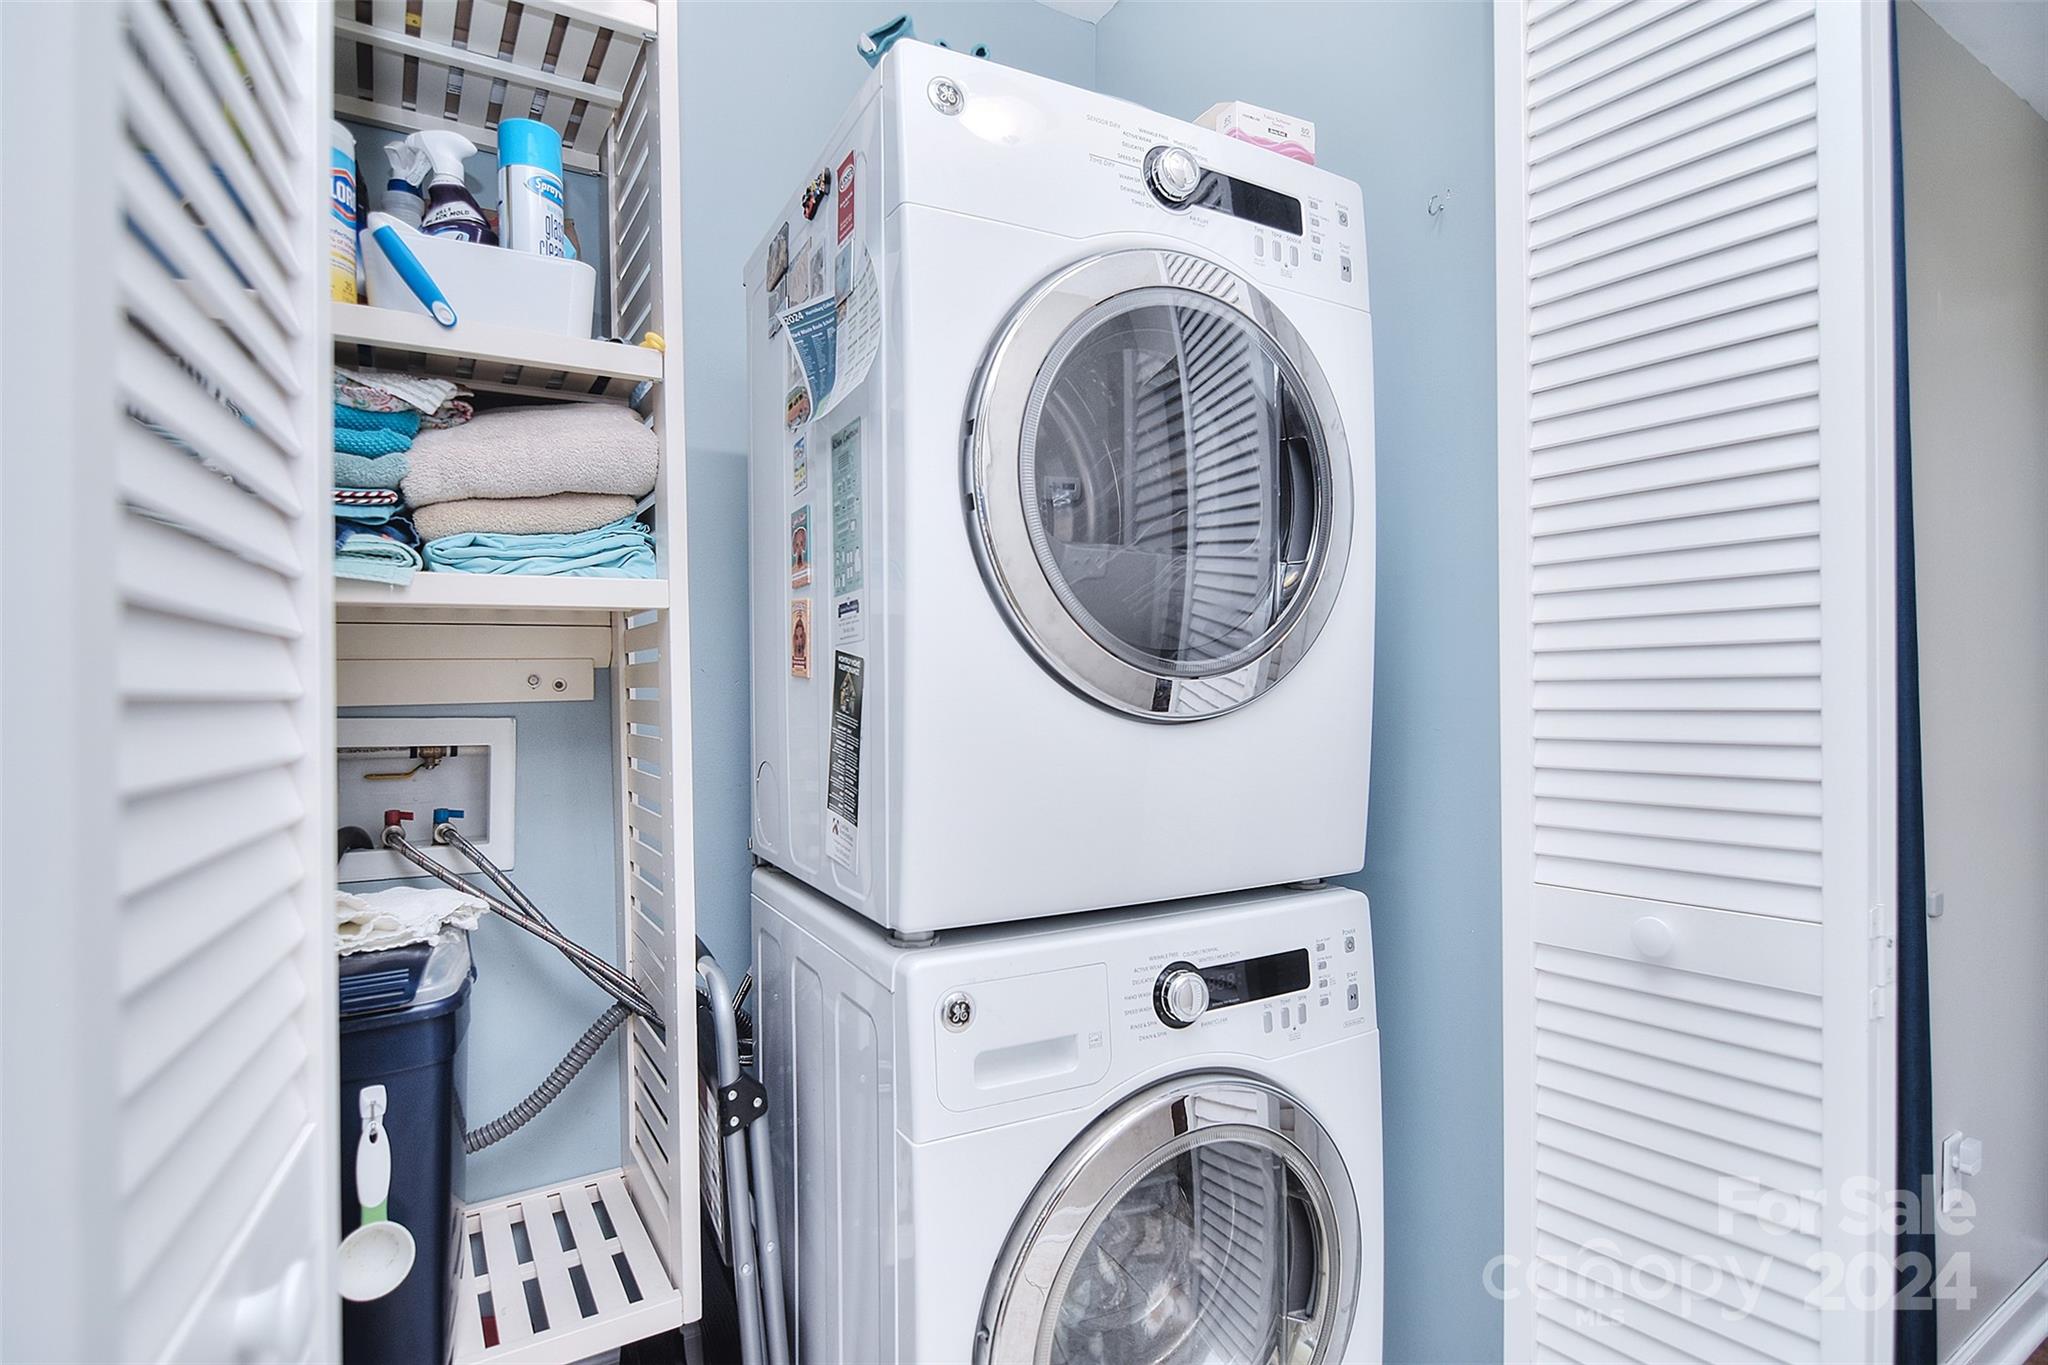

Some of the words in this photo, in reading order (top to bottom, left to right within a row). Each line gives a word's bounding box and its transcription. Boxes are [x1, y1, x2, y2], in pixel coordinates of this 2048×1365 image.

[449, 210, 470, 218] MOLD
[544, 214, 564, 244] glas
[784, 312, 804, 325] 2024
